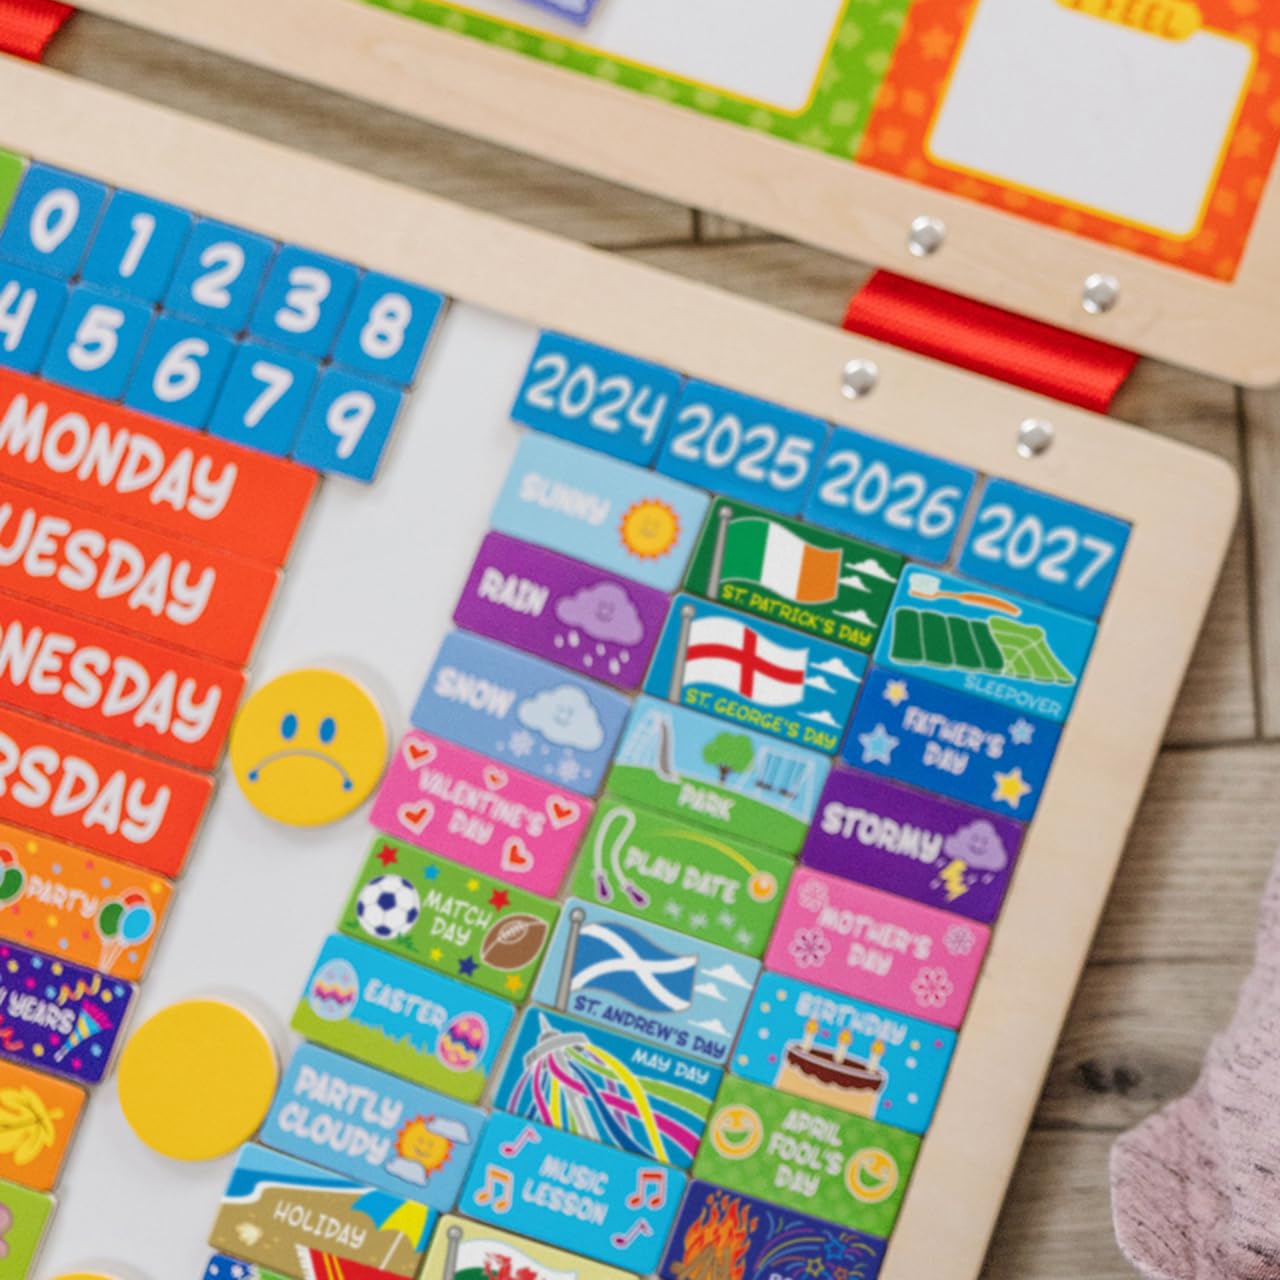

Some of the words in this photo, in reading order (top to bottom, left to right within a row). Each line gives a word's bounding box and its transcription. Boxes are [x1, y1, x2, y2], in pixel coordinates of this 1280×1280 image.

[29, 188, 80, 254] 0
[119, 213, 156, 278] 1
[191, 241, 245, 309] 2
[274, 266, 331, 333] 3
[359, 293, 413, 360] 8
[0, 280, 37, 352] 4
[68, 304, 125, 371] 5
[152, 337, 209, 402] 6
[243, 361, 293, 428] 7
[326, 391, 376, 460] 9
[0, 393, 238, 520] MONDAY
[525, 354, 667, 444] 2024
[670, 405, 813, 490] 2025
[818, 451, 961, 538] 2026
[973, 504, 1115, 590] 2027
[520, 472, 610, 526] SUNNY
[477, 566, 549, 617] RAIN
[749, 591, 836, 637] PATRICK'S
[837, 624, 874, 649] DAY
[0, 620, 221, 743] NESDAY
[434, 666, 516, 719] SNOW
[963, 672, 1063, 719] SLEEPOVER
[714, 701, 801, 740] GEORGE'S
[803, 725, 838, 751] DAY
[903, 706, 1006, 760] FATHER'S
[923, 741, 970, 776] DAY
[419, 769, 546, 838] VALENTINE'S
[677, 782, 735, 821] PARK
[448, 811, 494, 846] DAY
[821, 801, 944, 865] STORMY
[27, 876, 98, 920] PARTY
[624, 847, 682, 884] PLAY
[682, 865, 741, 905] DATE
[423, 889, 493, 929] MATCH
[430, 915, 473, 947] DAY
[817, 902, 932, 960] MOTHER'S
[847, 943, 893, 977] DAY
[7, 990, 76, 1035] YEARS
[363, 978, 448, 1027] EASTER
[795, 991, 908, 1047] BIRTHDAY
[601, 1003, 689, 1048] ANDREW'S
[691, 1035, 727, 1060] DAY
[631, 1048, 672, 1075] MAY
[674, 1062, 710, 1087] DAY
[294, 1065, 403, 1130] PARTLY
[277, 1101, 391, 1166] CLOUDY
[782, 1109, 844, 1148] APRIL
[539, 1153, 609, 1195] MUSIC
[766, 1131, 844, 1177] FOOL'S
[522, 1178, 609, 1226] LESSON
[774, 1165, 820, 1199] DAY
[273, 1200, 368, 1249] HOLIDAY
